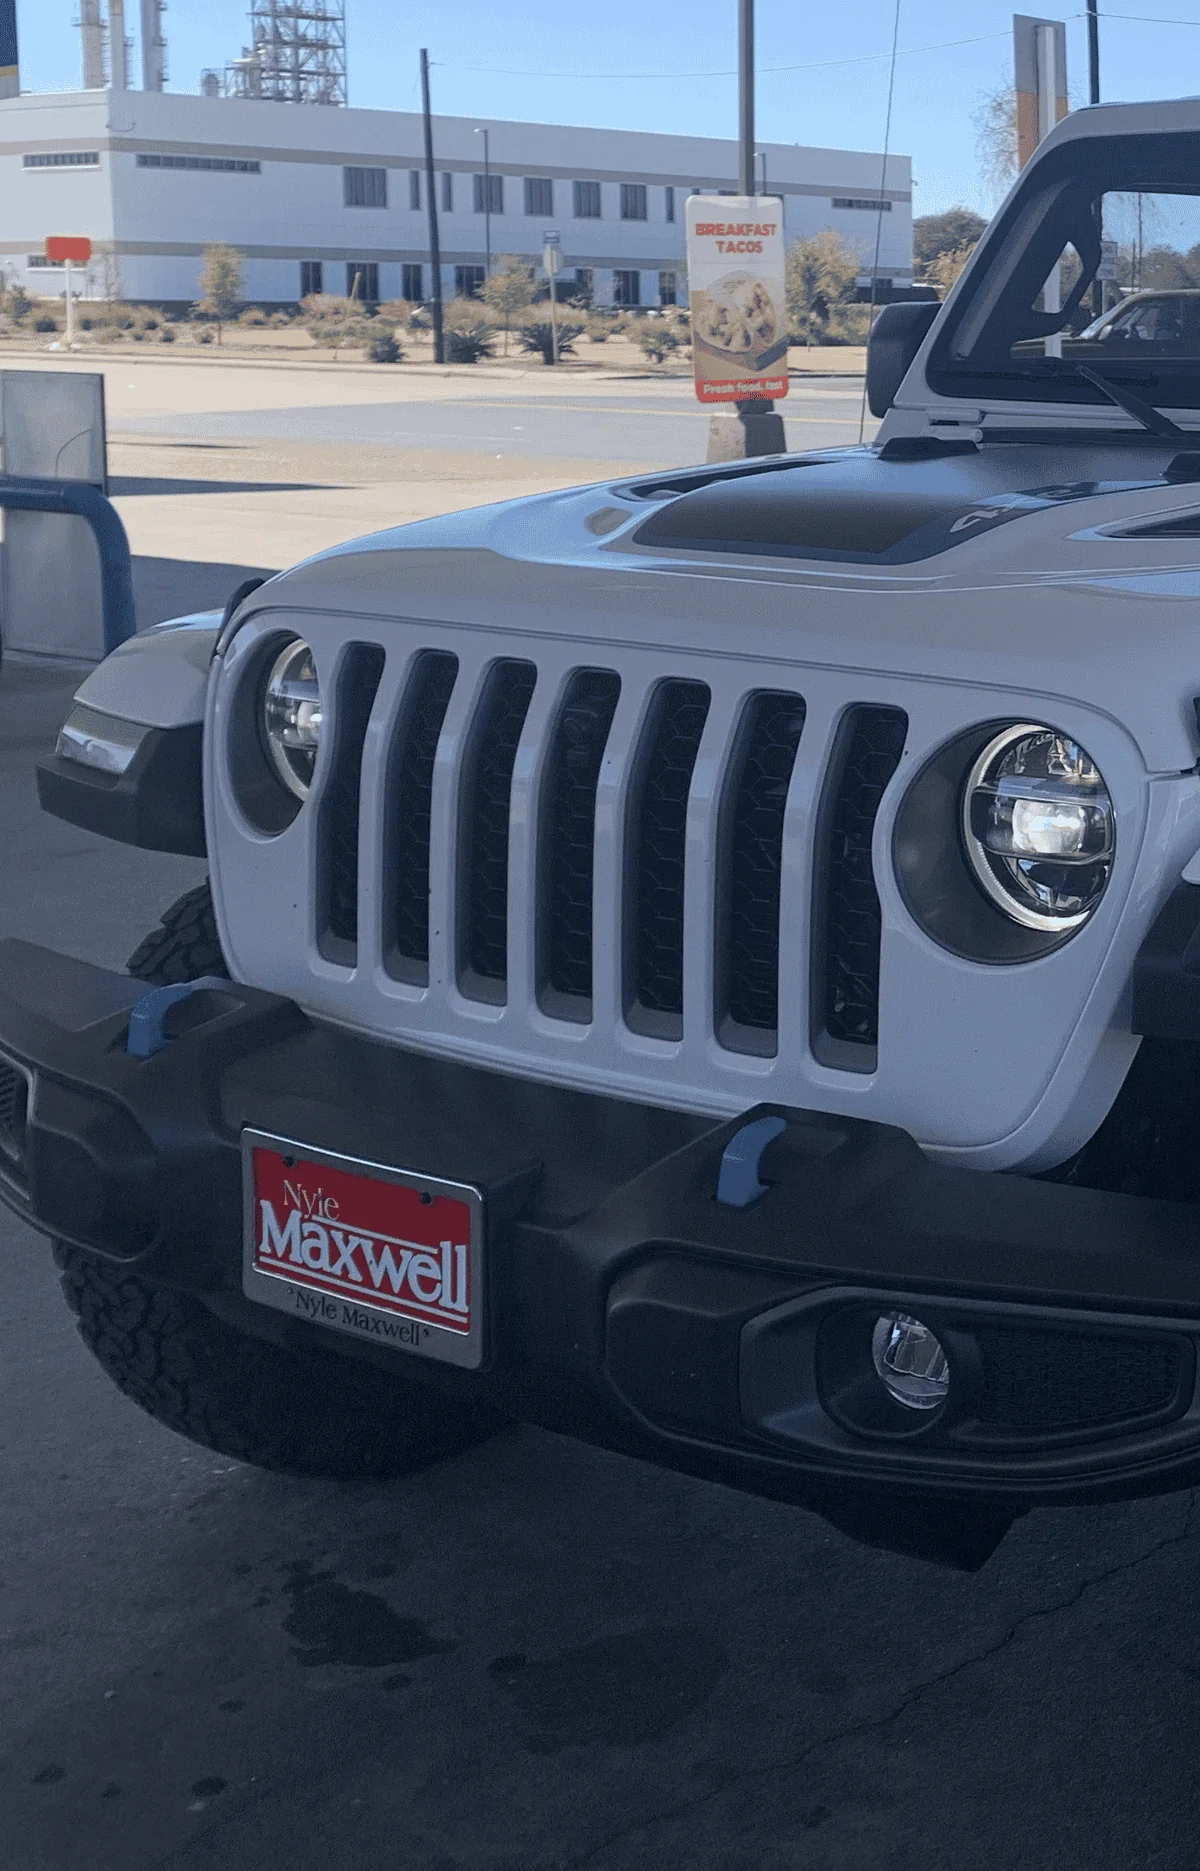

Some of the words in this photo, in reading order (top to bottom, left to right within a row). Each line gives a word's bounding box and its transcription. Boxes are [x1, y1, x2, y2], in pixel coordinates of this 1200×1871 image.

[695, 223, 777, 237] BREAKFAST
[716, 240, 763, 254] TACOS
[703, 383, 735, 395] Fresh
[283, 1179, 340, 1221] Nyle
[259, 1199, 469, 1314] Maxwell
[296, 1291, 337, 1320] Nyle
[341, 1305, 420, 1346] Maxwell
